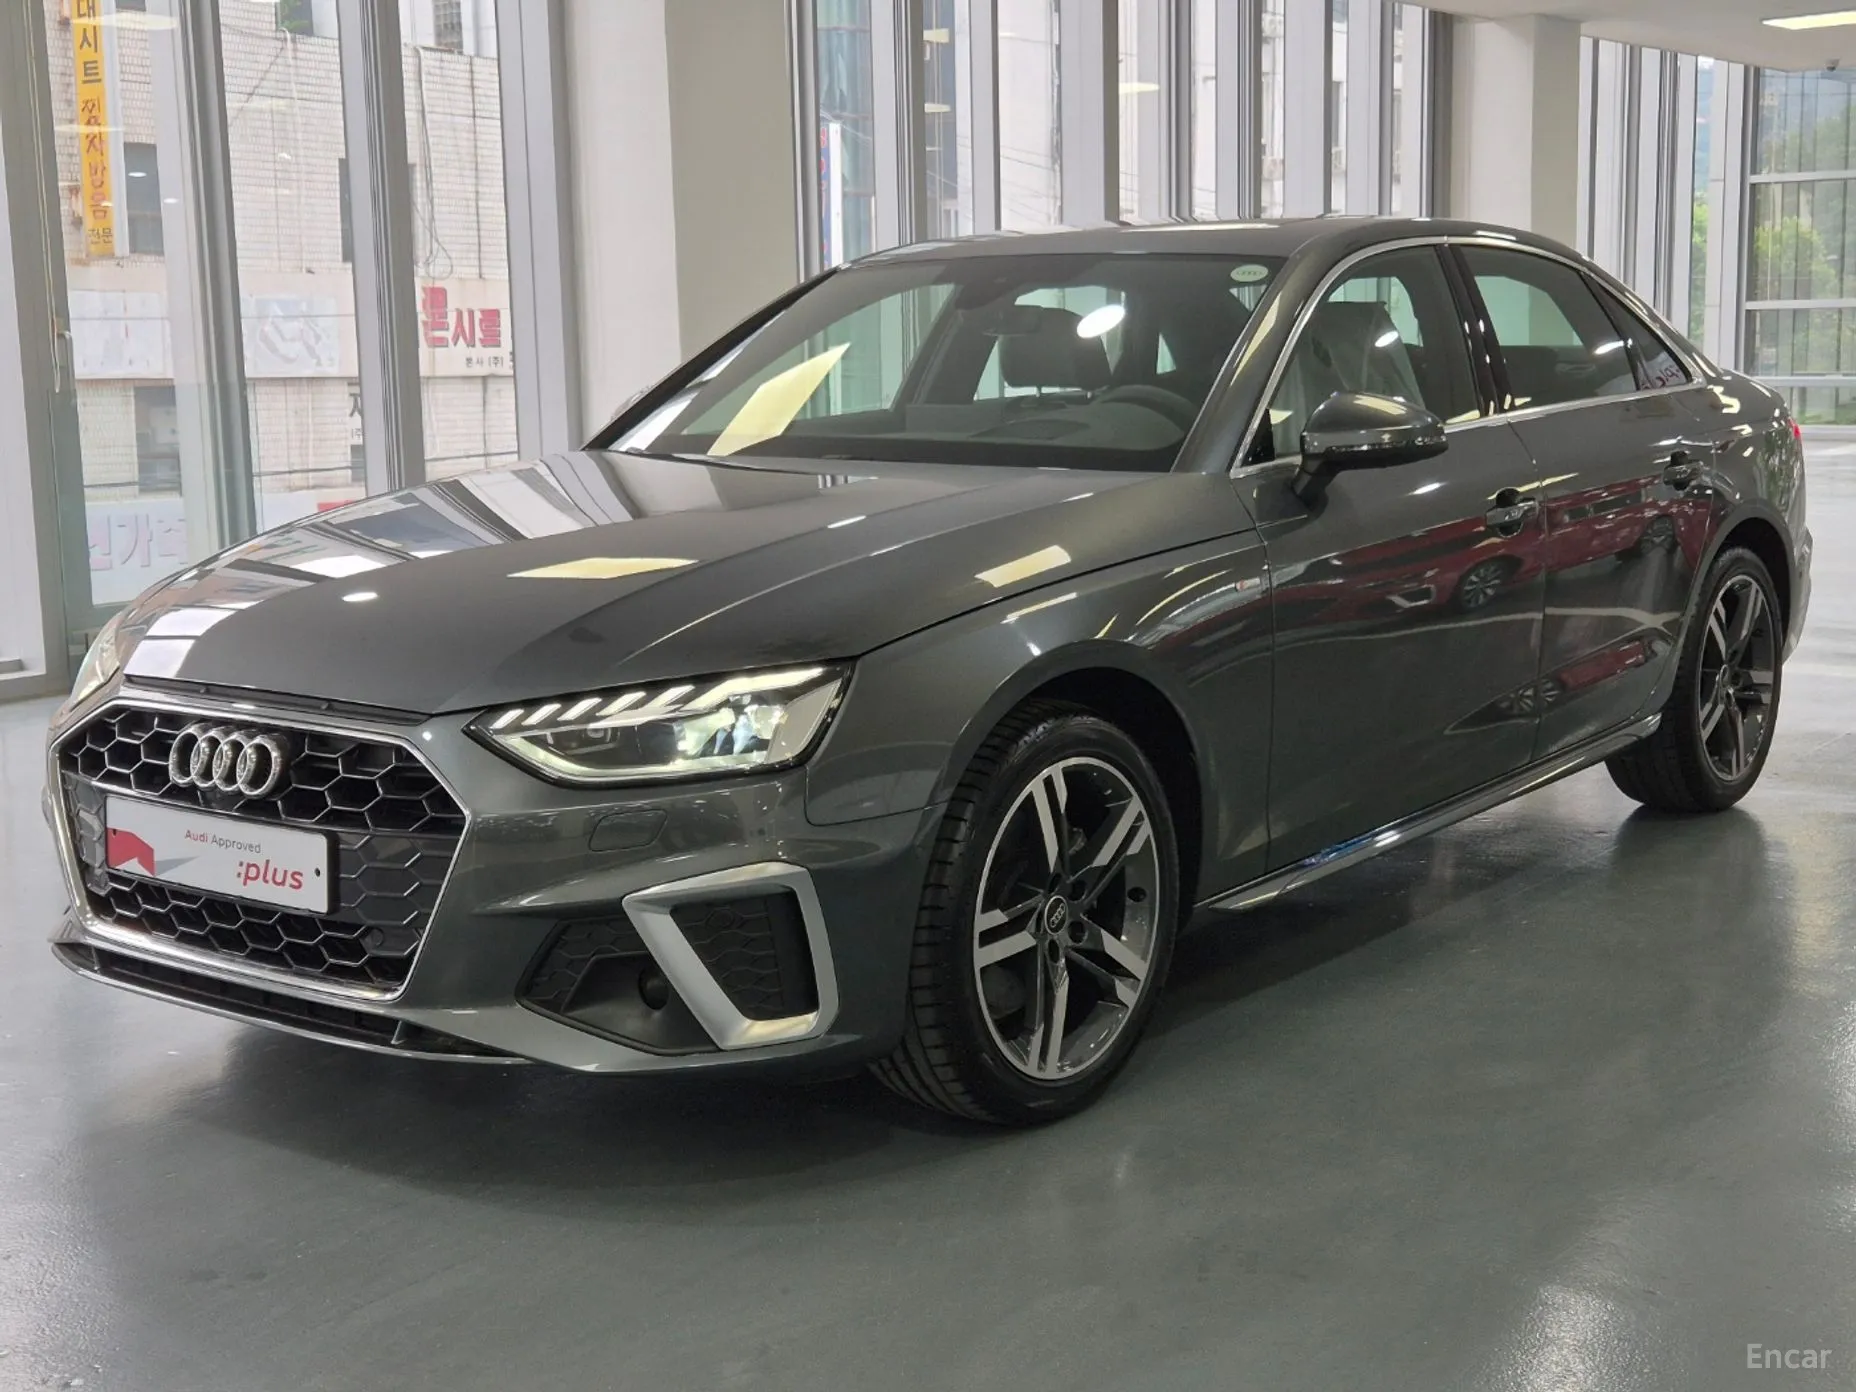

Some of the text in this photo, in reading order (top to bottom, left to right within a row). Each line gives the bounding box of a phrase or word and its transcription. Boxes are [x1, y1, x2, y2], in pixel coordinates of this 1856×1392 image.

[184, 829, 262, 854] Audi Approved
[236, 859, 304, 890] :plus
